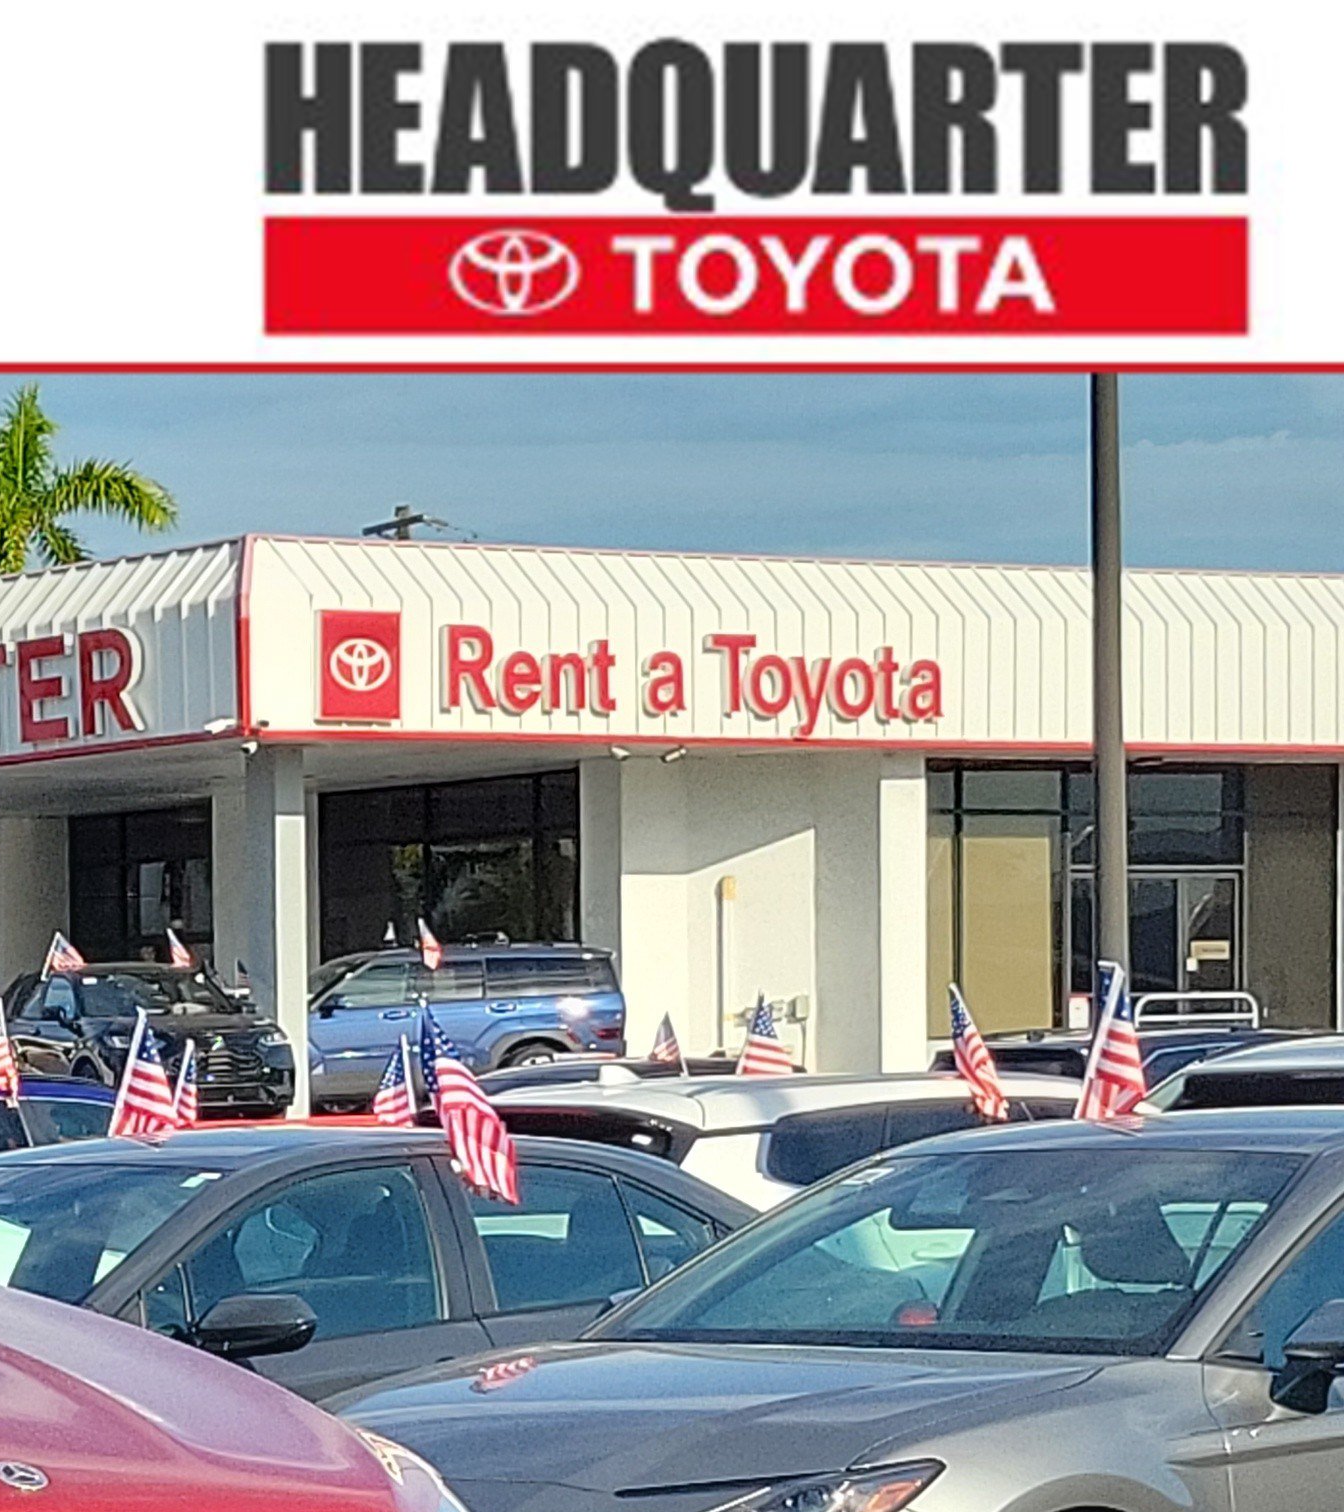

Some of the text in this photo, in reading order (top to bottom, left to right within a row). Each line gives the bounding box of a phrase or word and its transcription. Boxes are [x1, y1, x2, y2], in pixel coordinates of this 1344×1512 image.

[440, 623, 944, 739] Rent a Toyota
